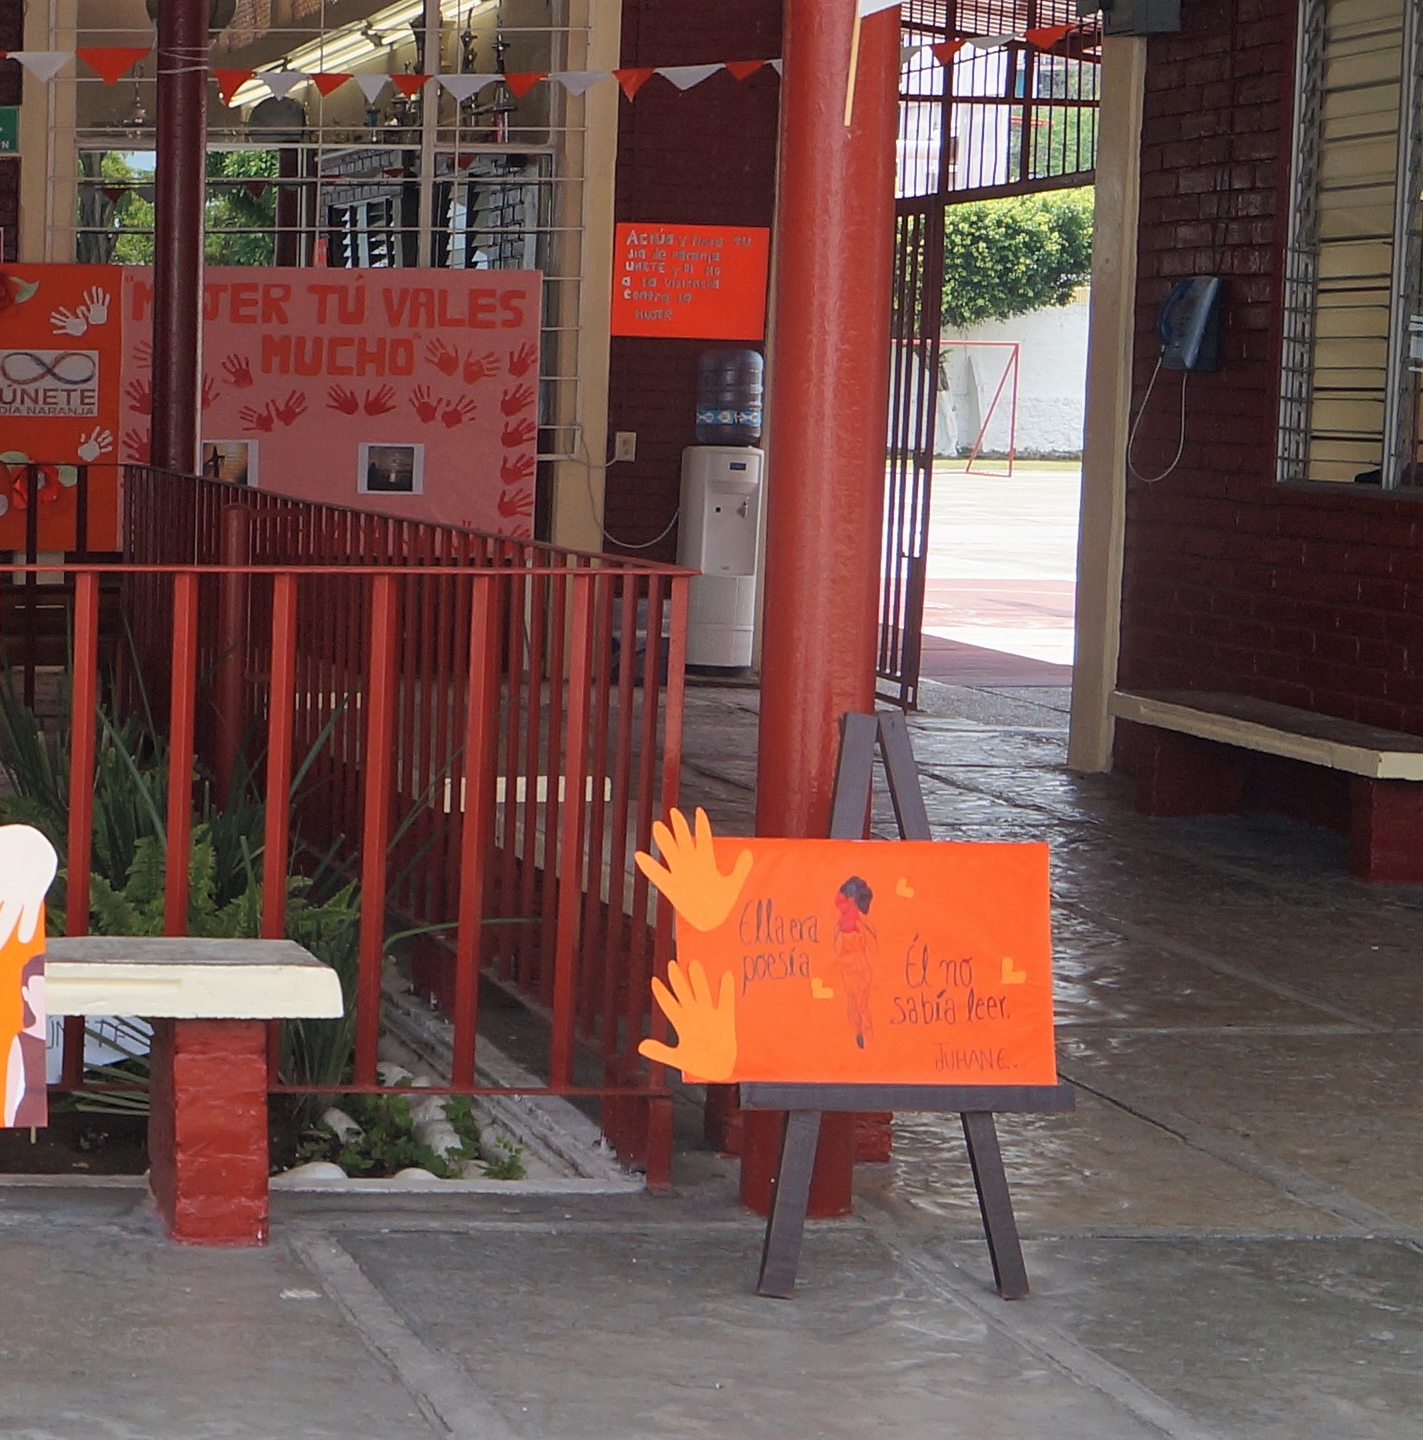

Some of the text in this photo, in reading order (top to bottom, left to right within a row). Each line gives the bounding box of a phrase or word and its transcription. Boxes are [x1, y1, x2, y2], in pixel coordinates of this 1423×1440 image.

[307, 273, 366, 325] TÚ
[381, 288, 527, 328] VALES
[0, 384, 96, 406] ÚNETE
[26, 406, 94, 416] NARANJA
[739, 898, 819, 946] Ella era
[742, 946, 810, 997] poesía
[905, 933, 973, 989] Él no
[890, 989, 956, 1025] sabía
